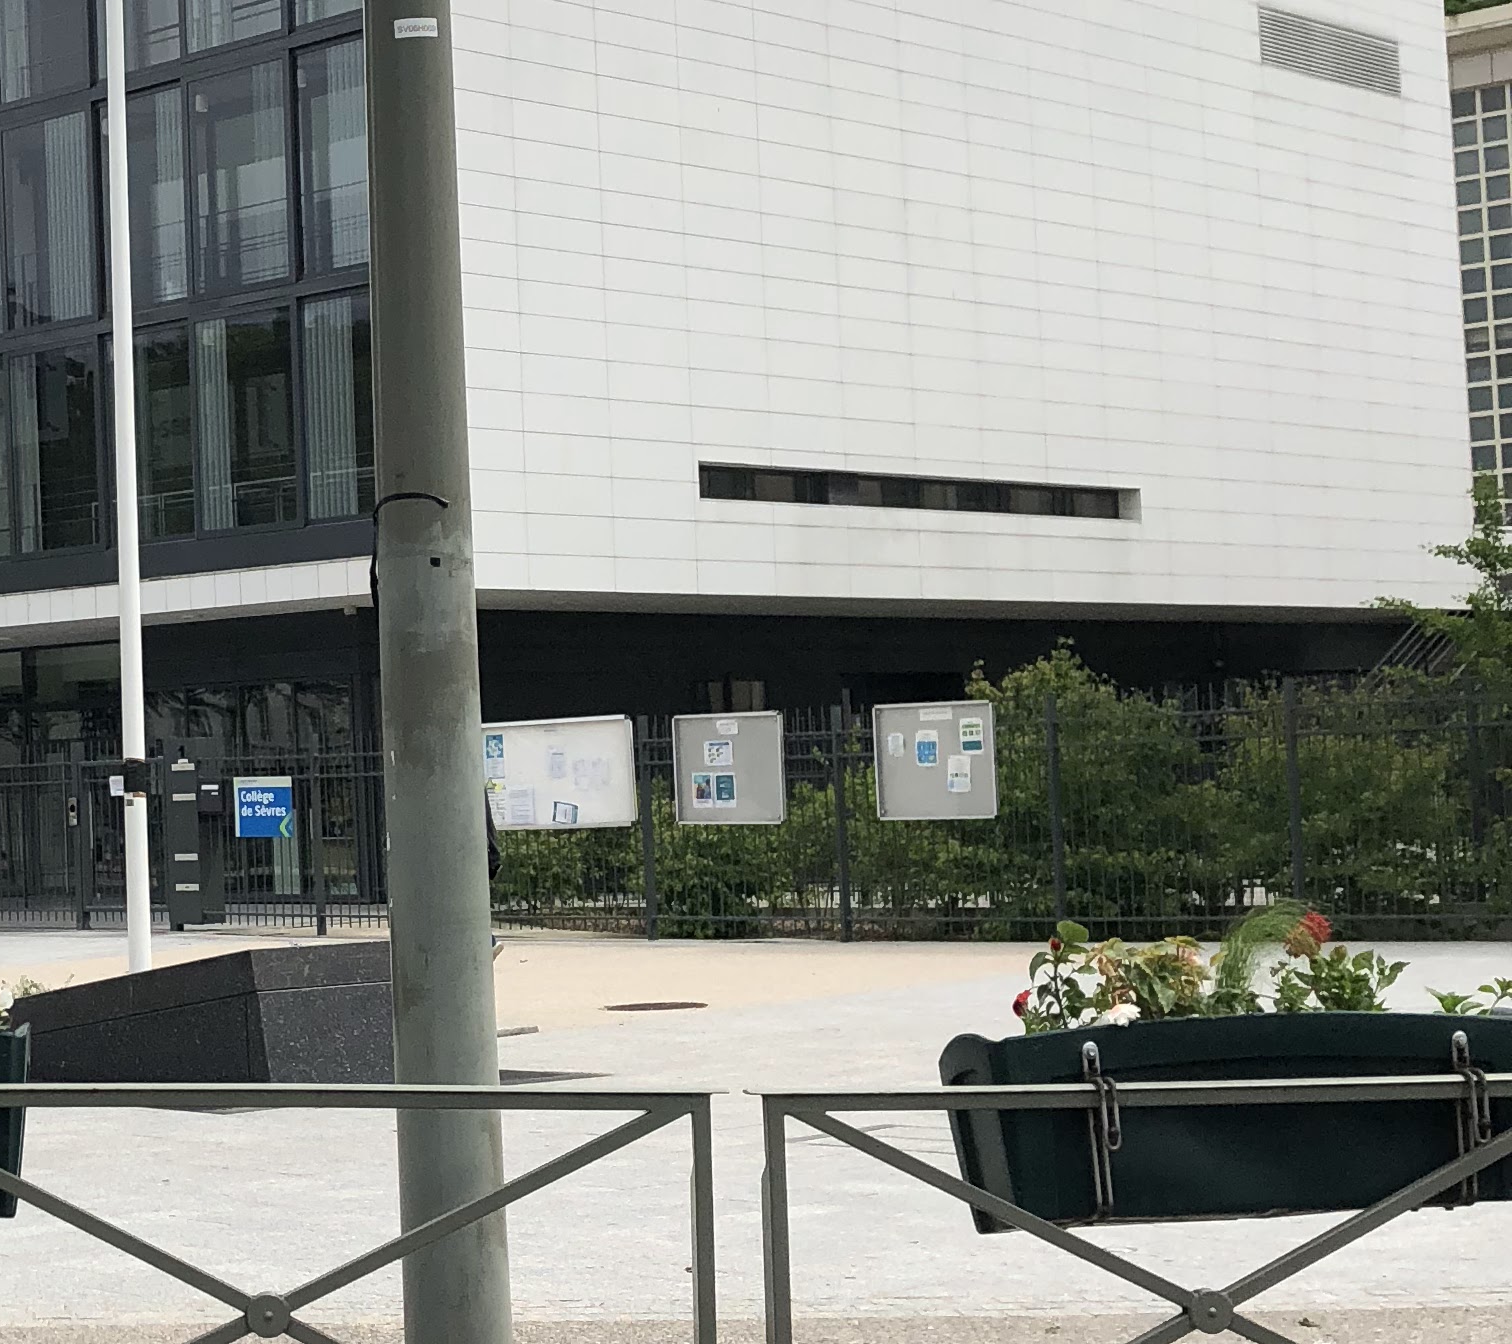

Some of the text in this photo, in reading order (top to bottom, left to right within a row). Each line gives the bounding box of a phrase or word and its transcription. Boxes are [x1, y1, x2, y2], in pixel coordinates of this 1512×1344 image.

[241, 790, 274, 804] Collège
[241, 805, 286, 816] de Sèvres
